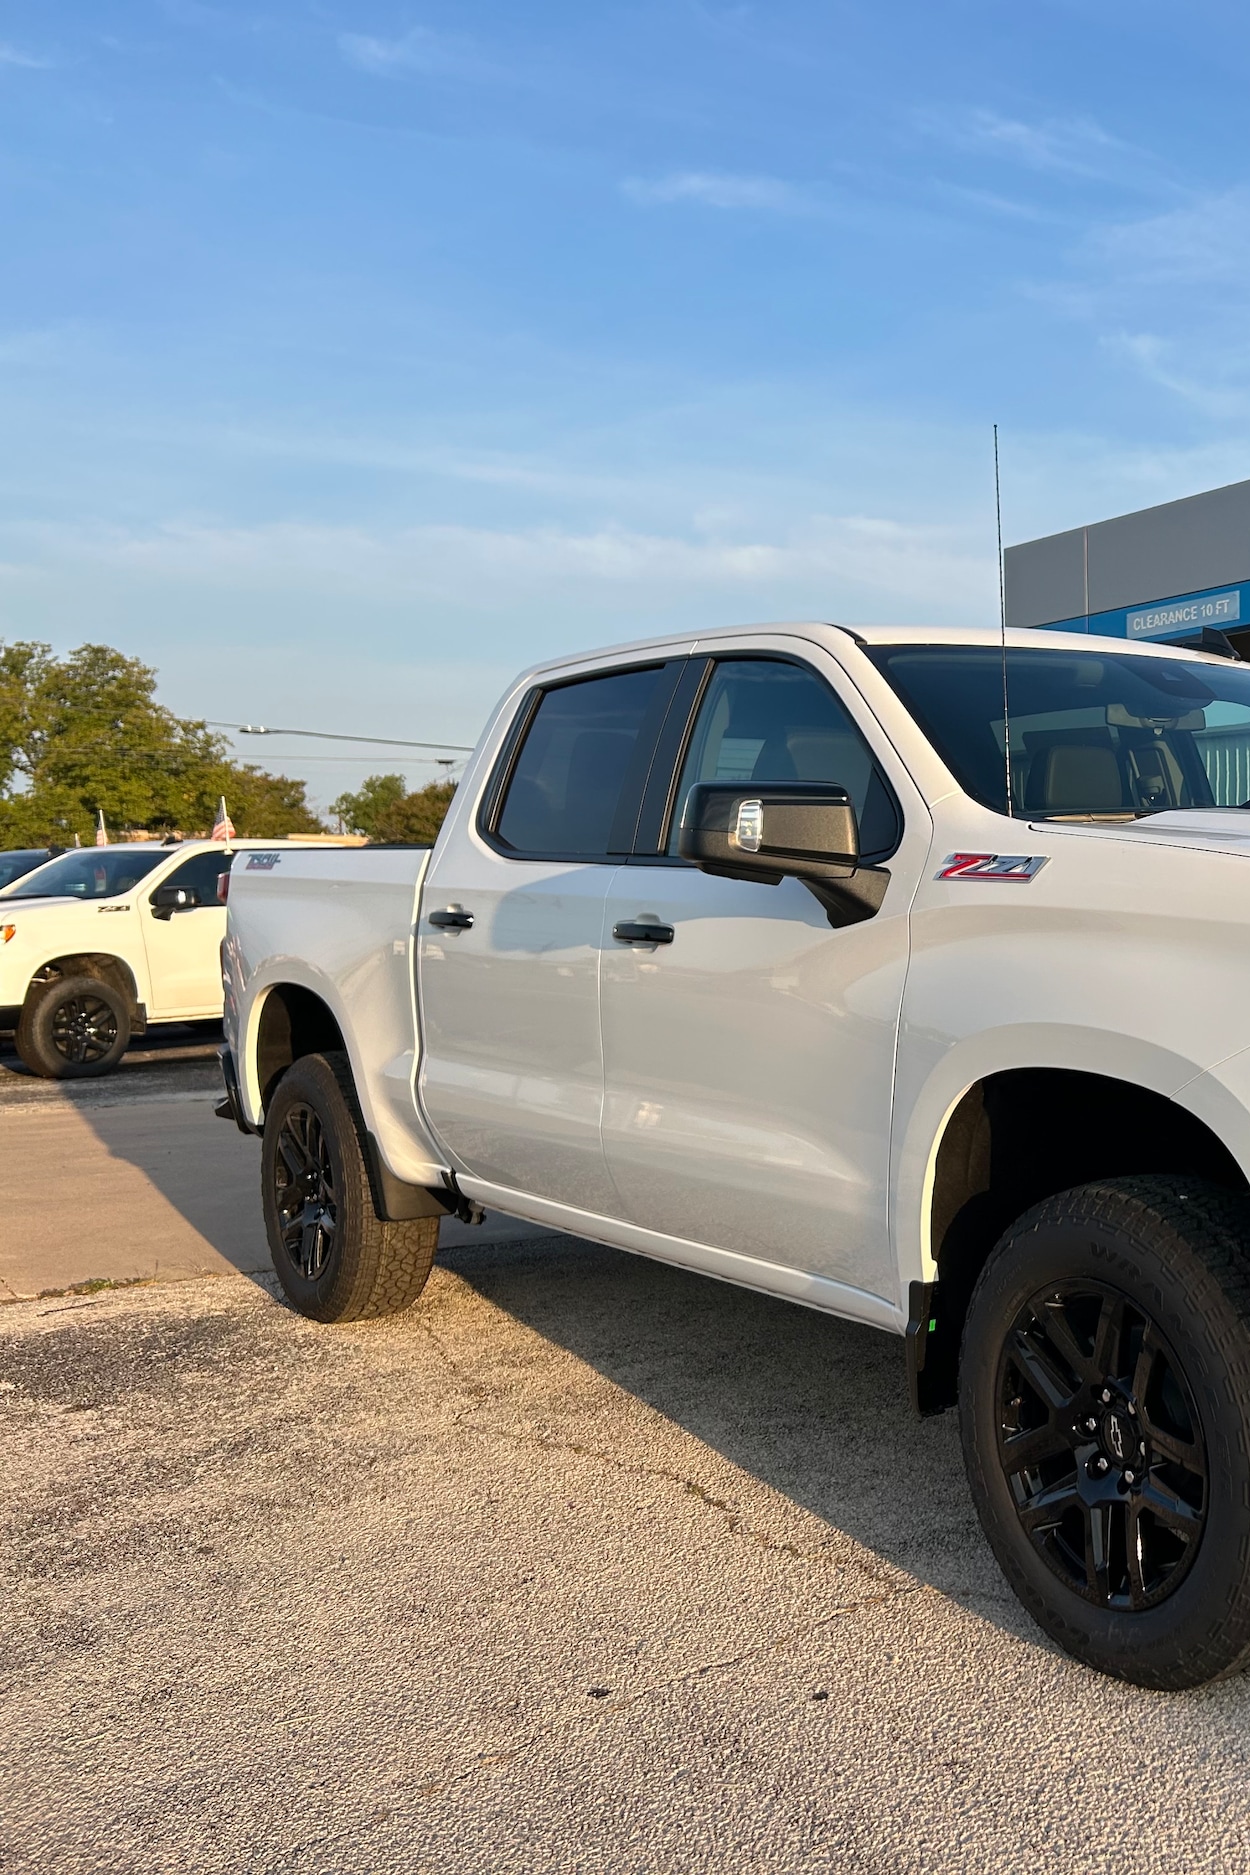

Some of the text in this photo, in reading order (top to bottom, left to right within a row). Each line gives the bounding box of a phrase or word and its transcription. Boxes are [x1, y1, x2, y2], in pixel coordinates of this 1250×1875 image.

[1133, 599, 1231, 632] CLEARANCE 10 FT
[932, 852, 1051, 884] Z71
